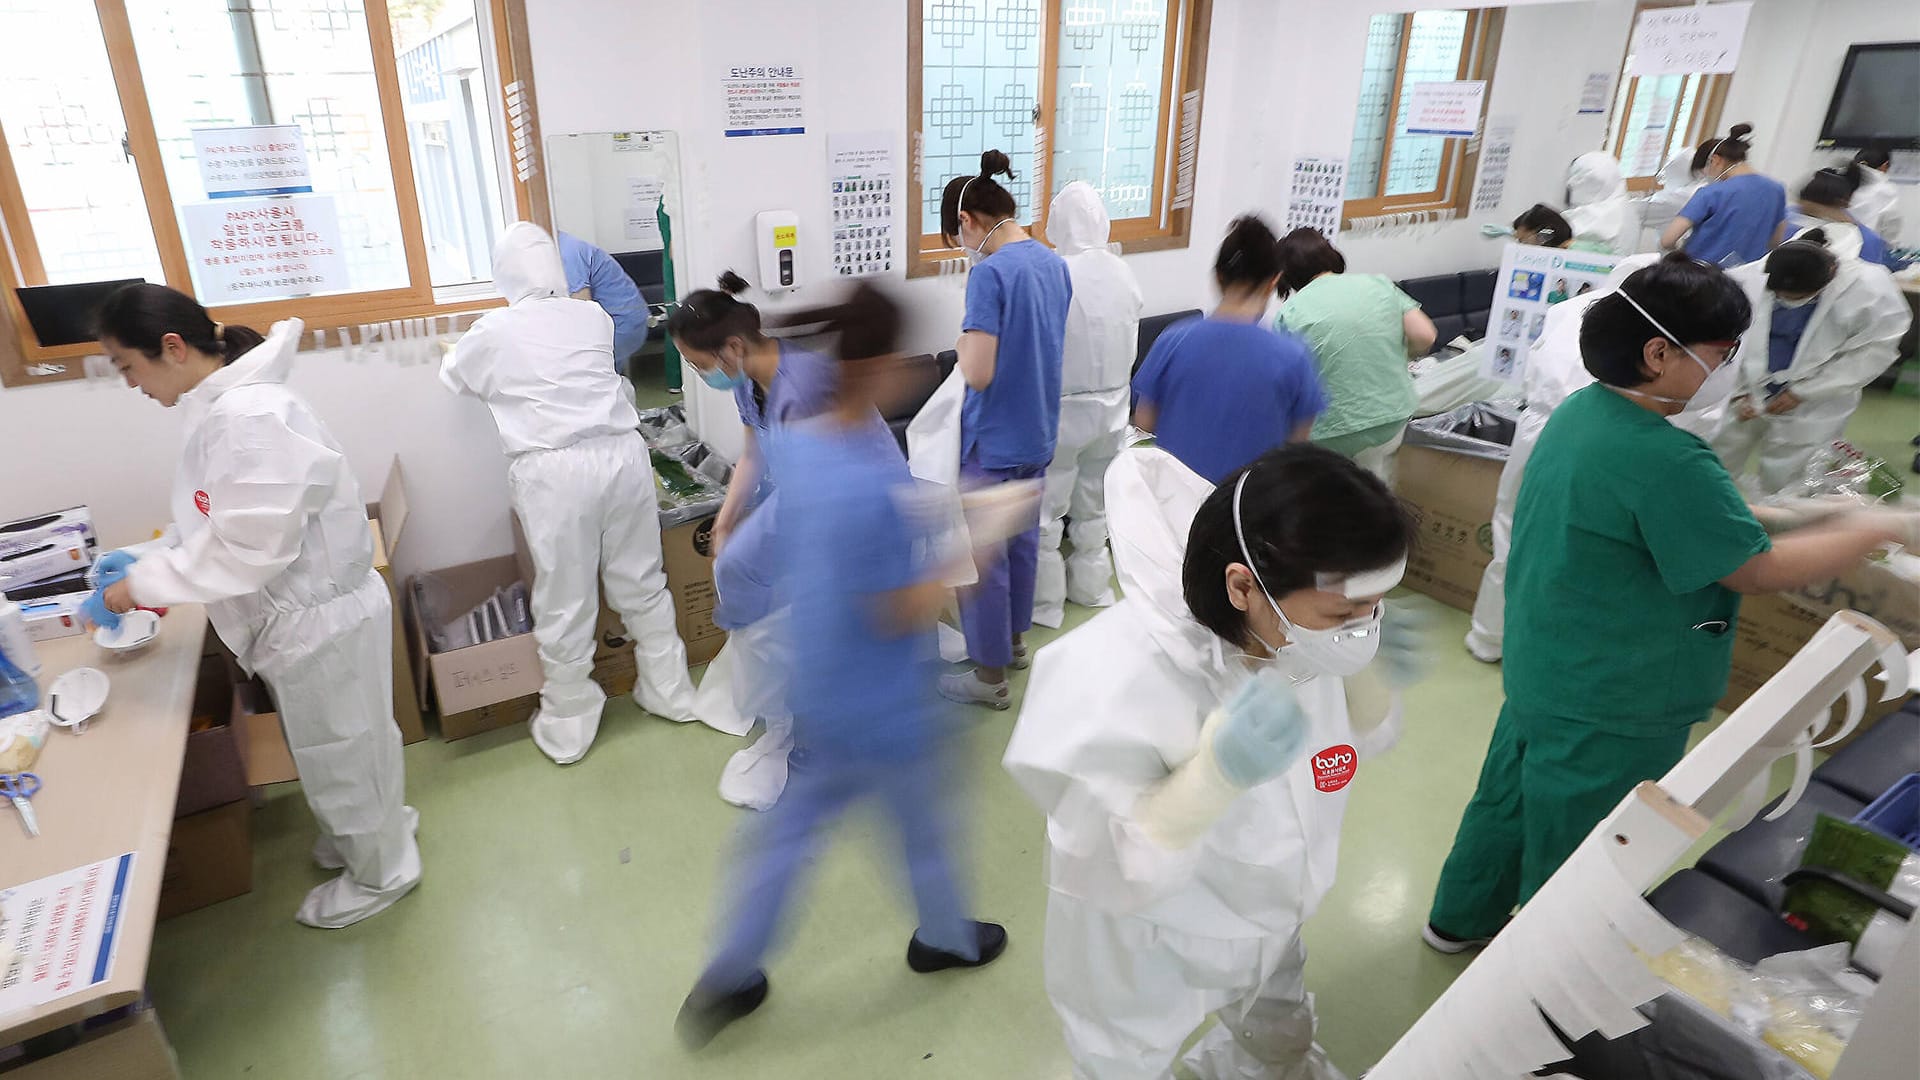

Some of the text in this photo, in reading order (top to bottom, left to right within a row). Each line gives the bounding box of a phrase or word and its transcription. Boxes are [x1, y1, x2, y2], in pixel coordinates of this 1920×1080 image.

[227, 206, 295, 222] PAPR사용시
[223, 219, 305, 237] 일반 마스크를
[210, 234, 278, 251] 착용하시면
[1315, 752, 1352, 770] boho
